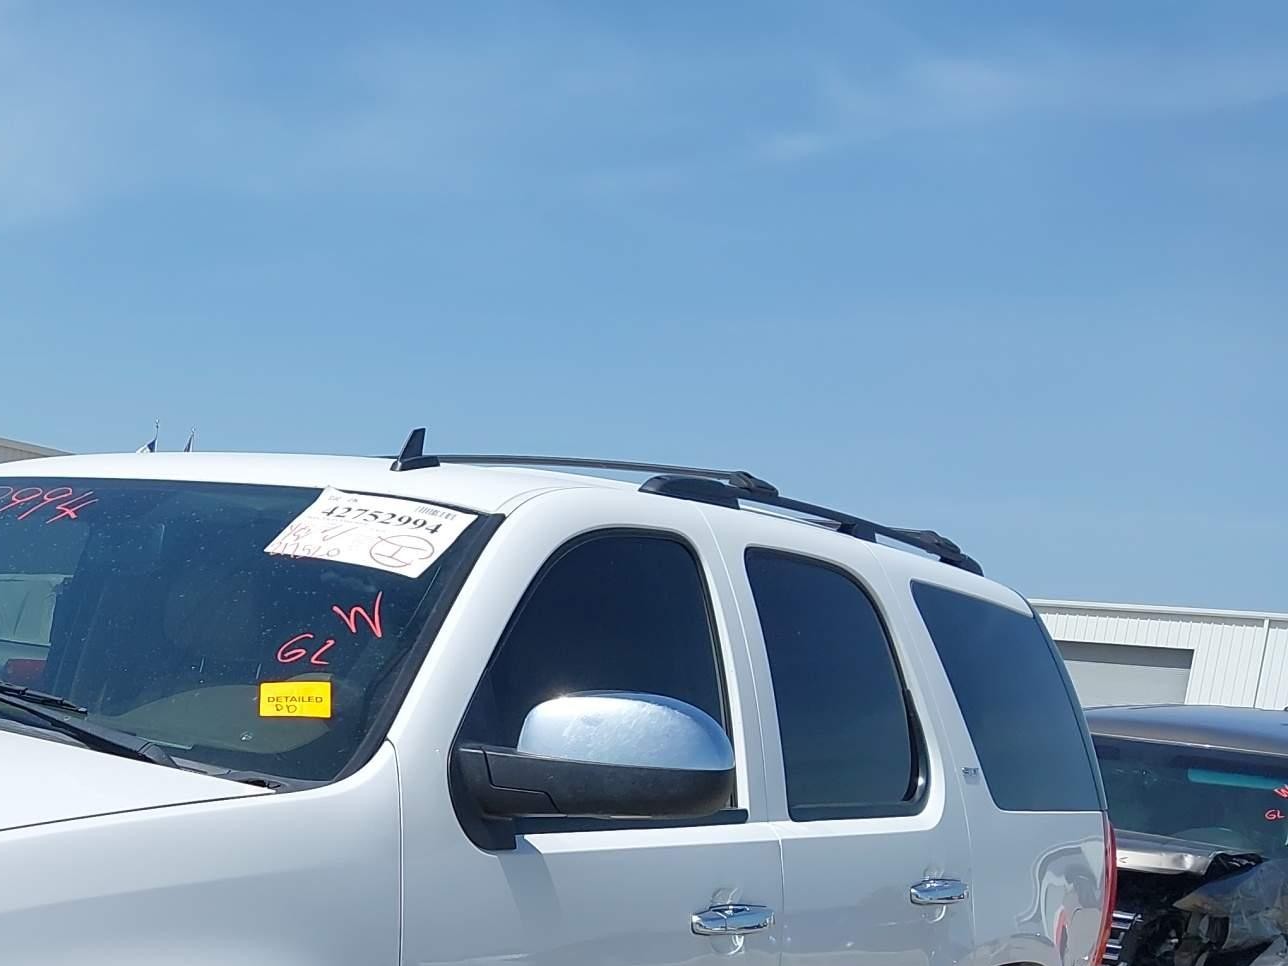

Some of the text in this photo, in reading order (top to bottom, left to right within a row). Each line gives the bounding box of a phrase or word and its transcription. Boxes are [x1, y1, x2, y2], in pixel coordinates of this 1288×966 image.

[321, 506, 443, 535] 42752994
[332, 591, 382, 638] W
[267, 695, 323, 703] DETAILED
